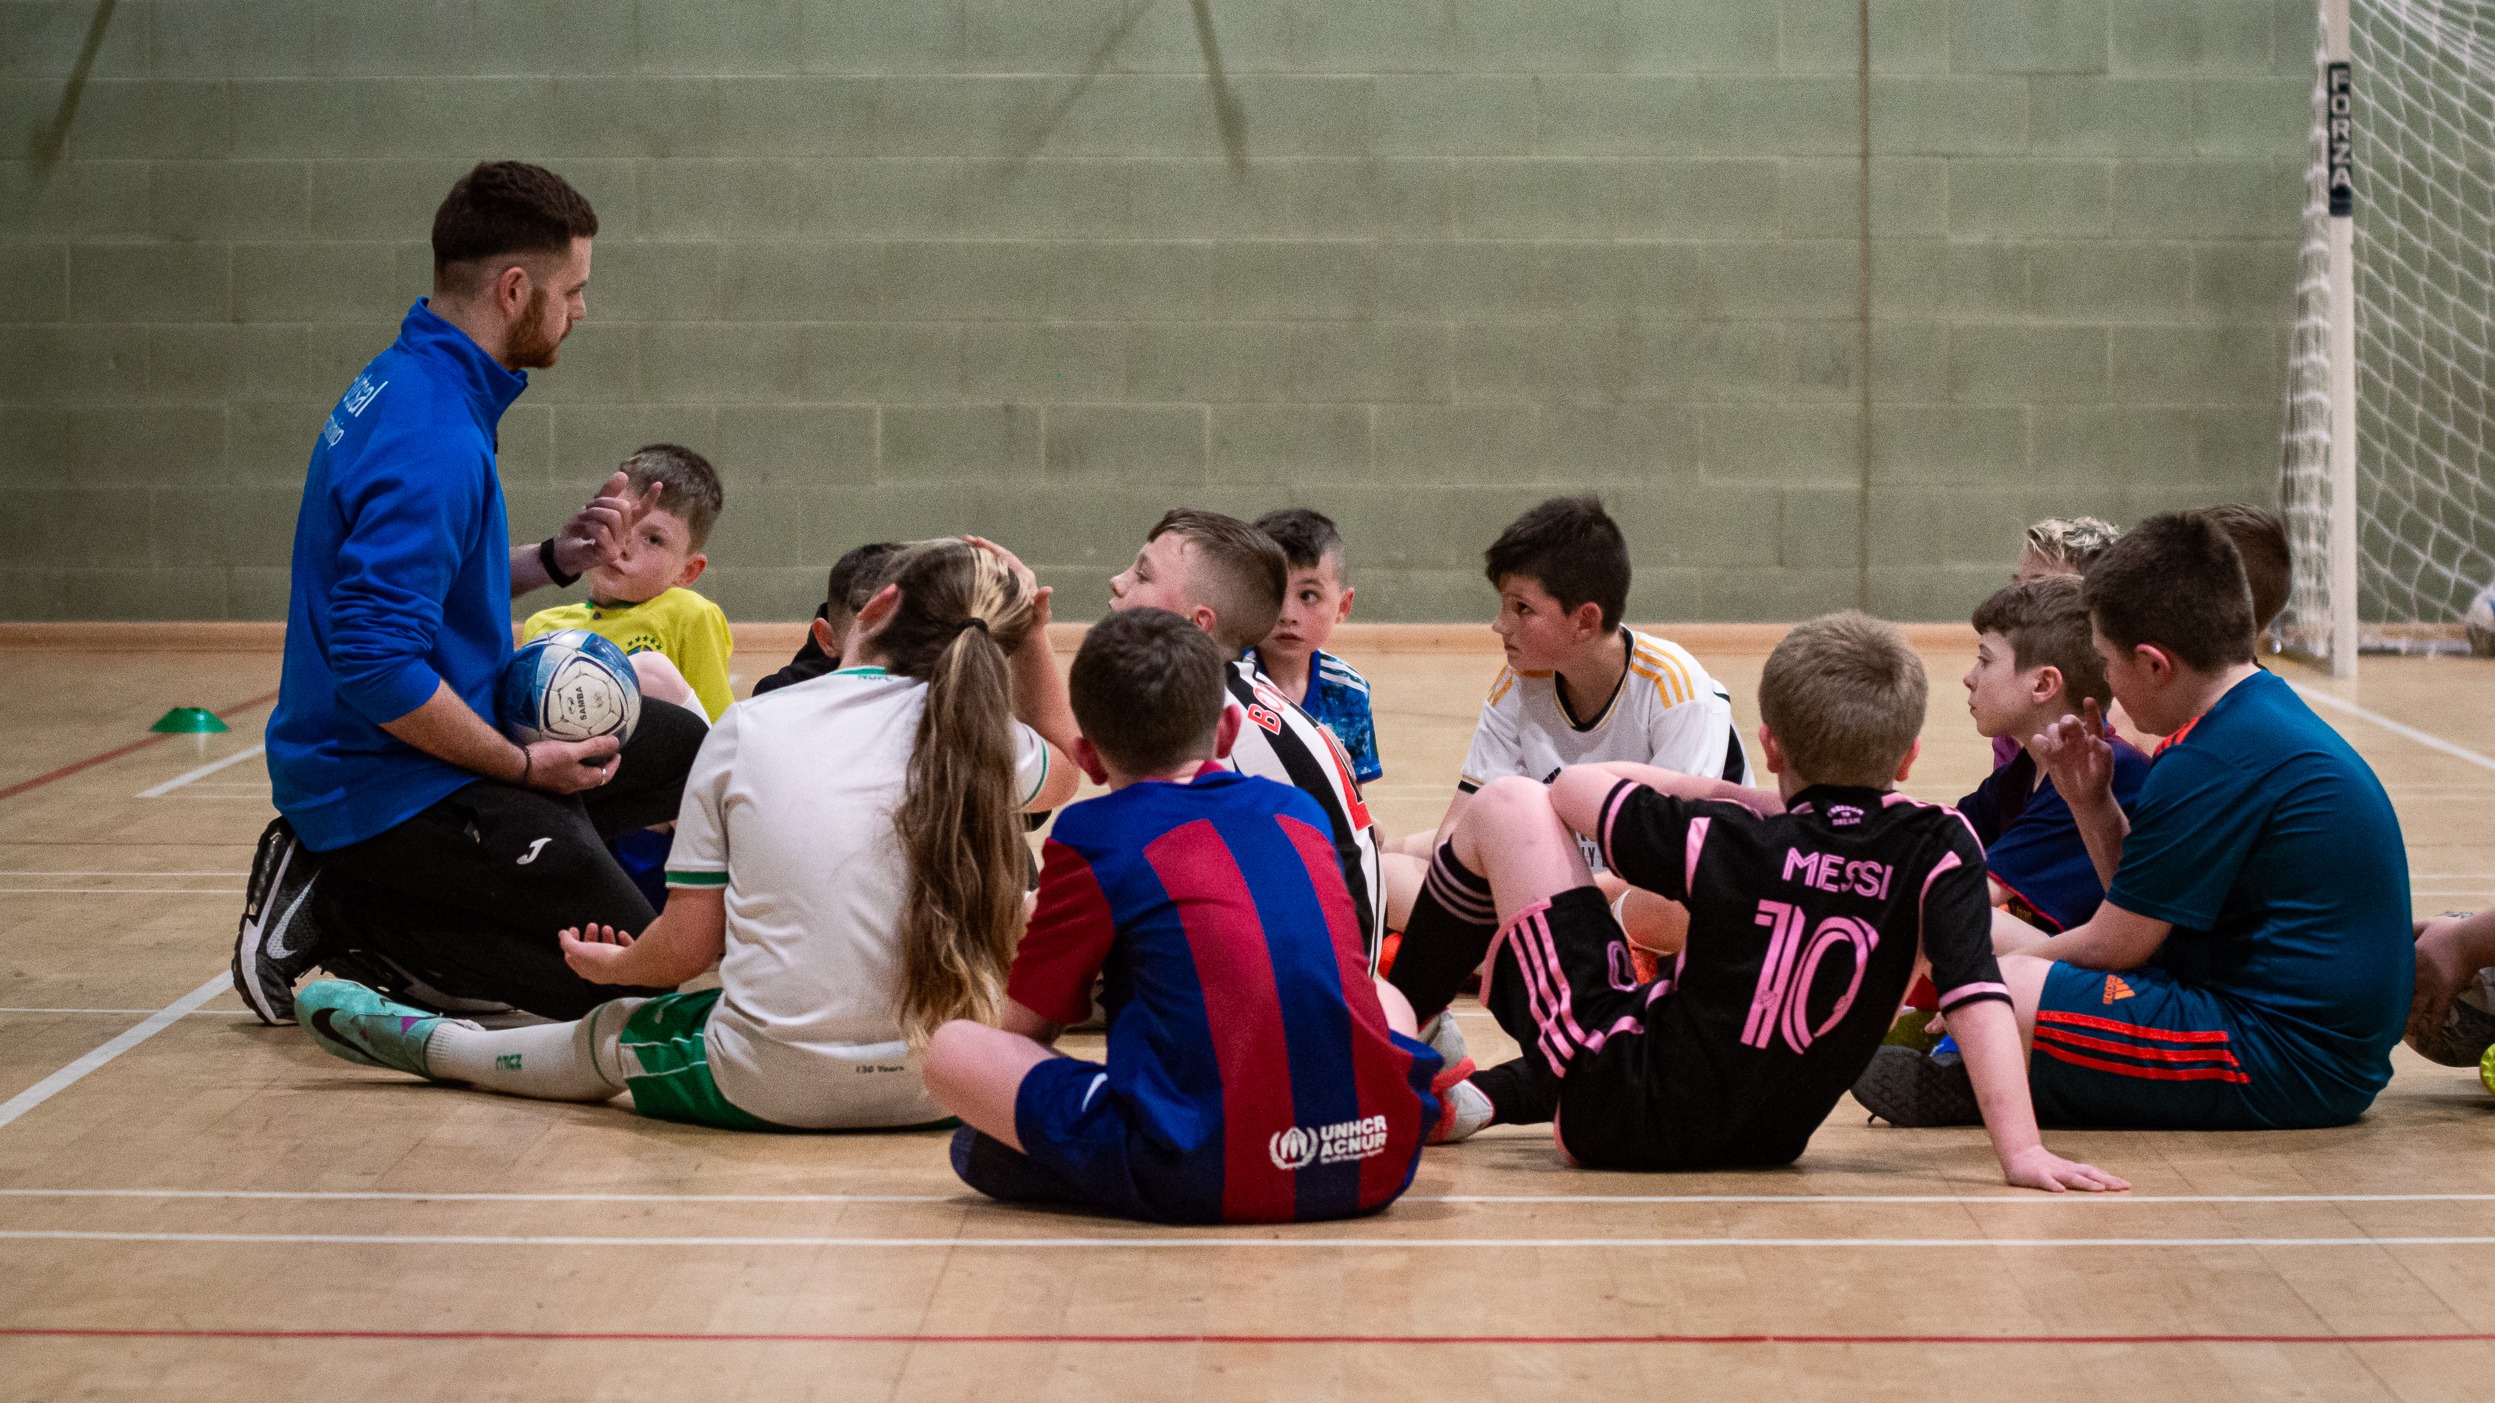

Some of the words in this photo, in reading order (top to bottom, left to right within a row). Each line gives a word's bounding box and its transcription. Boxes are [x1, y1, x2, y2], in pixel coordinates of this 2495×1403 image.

[2331, 69, 2351, 188] FORZA
[575, 686, 587, 720] SAMBA
[1247, 682, 1291, 736] BO
[1782, 847, 1894, 900] MESSI
[1740, 899, 1880, 1055] 10
[1320, 1115, 1387, 1141] UNHCR
[1320, 1132, 1387, 1158] ACNUR
